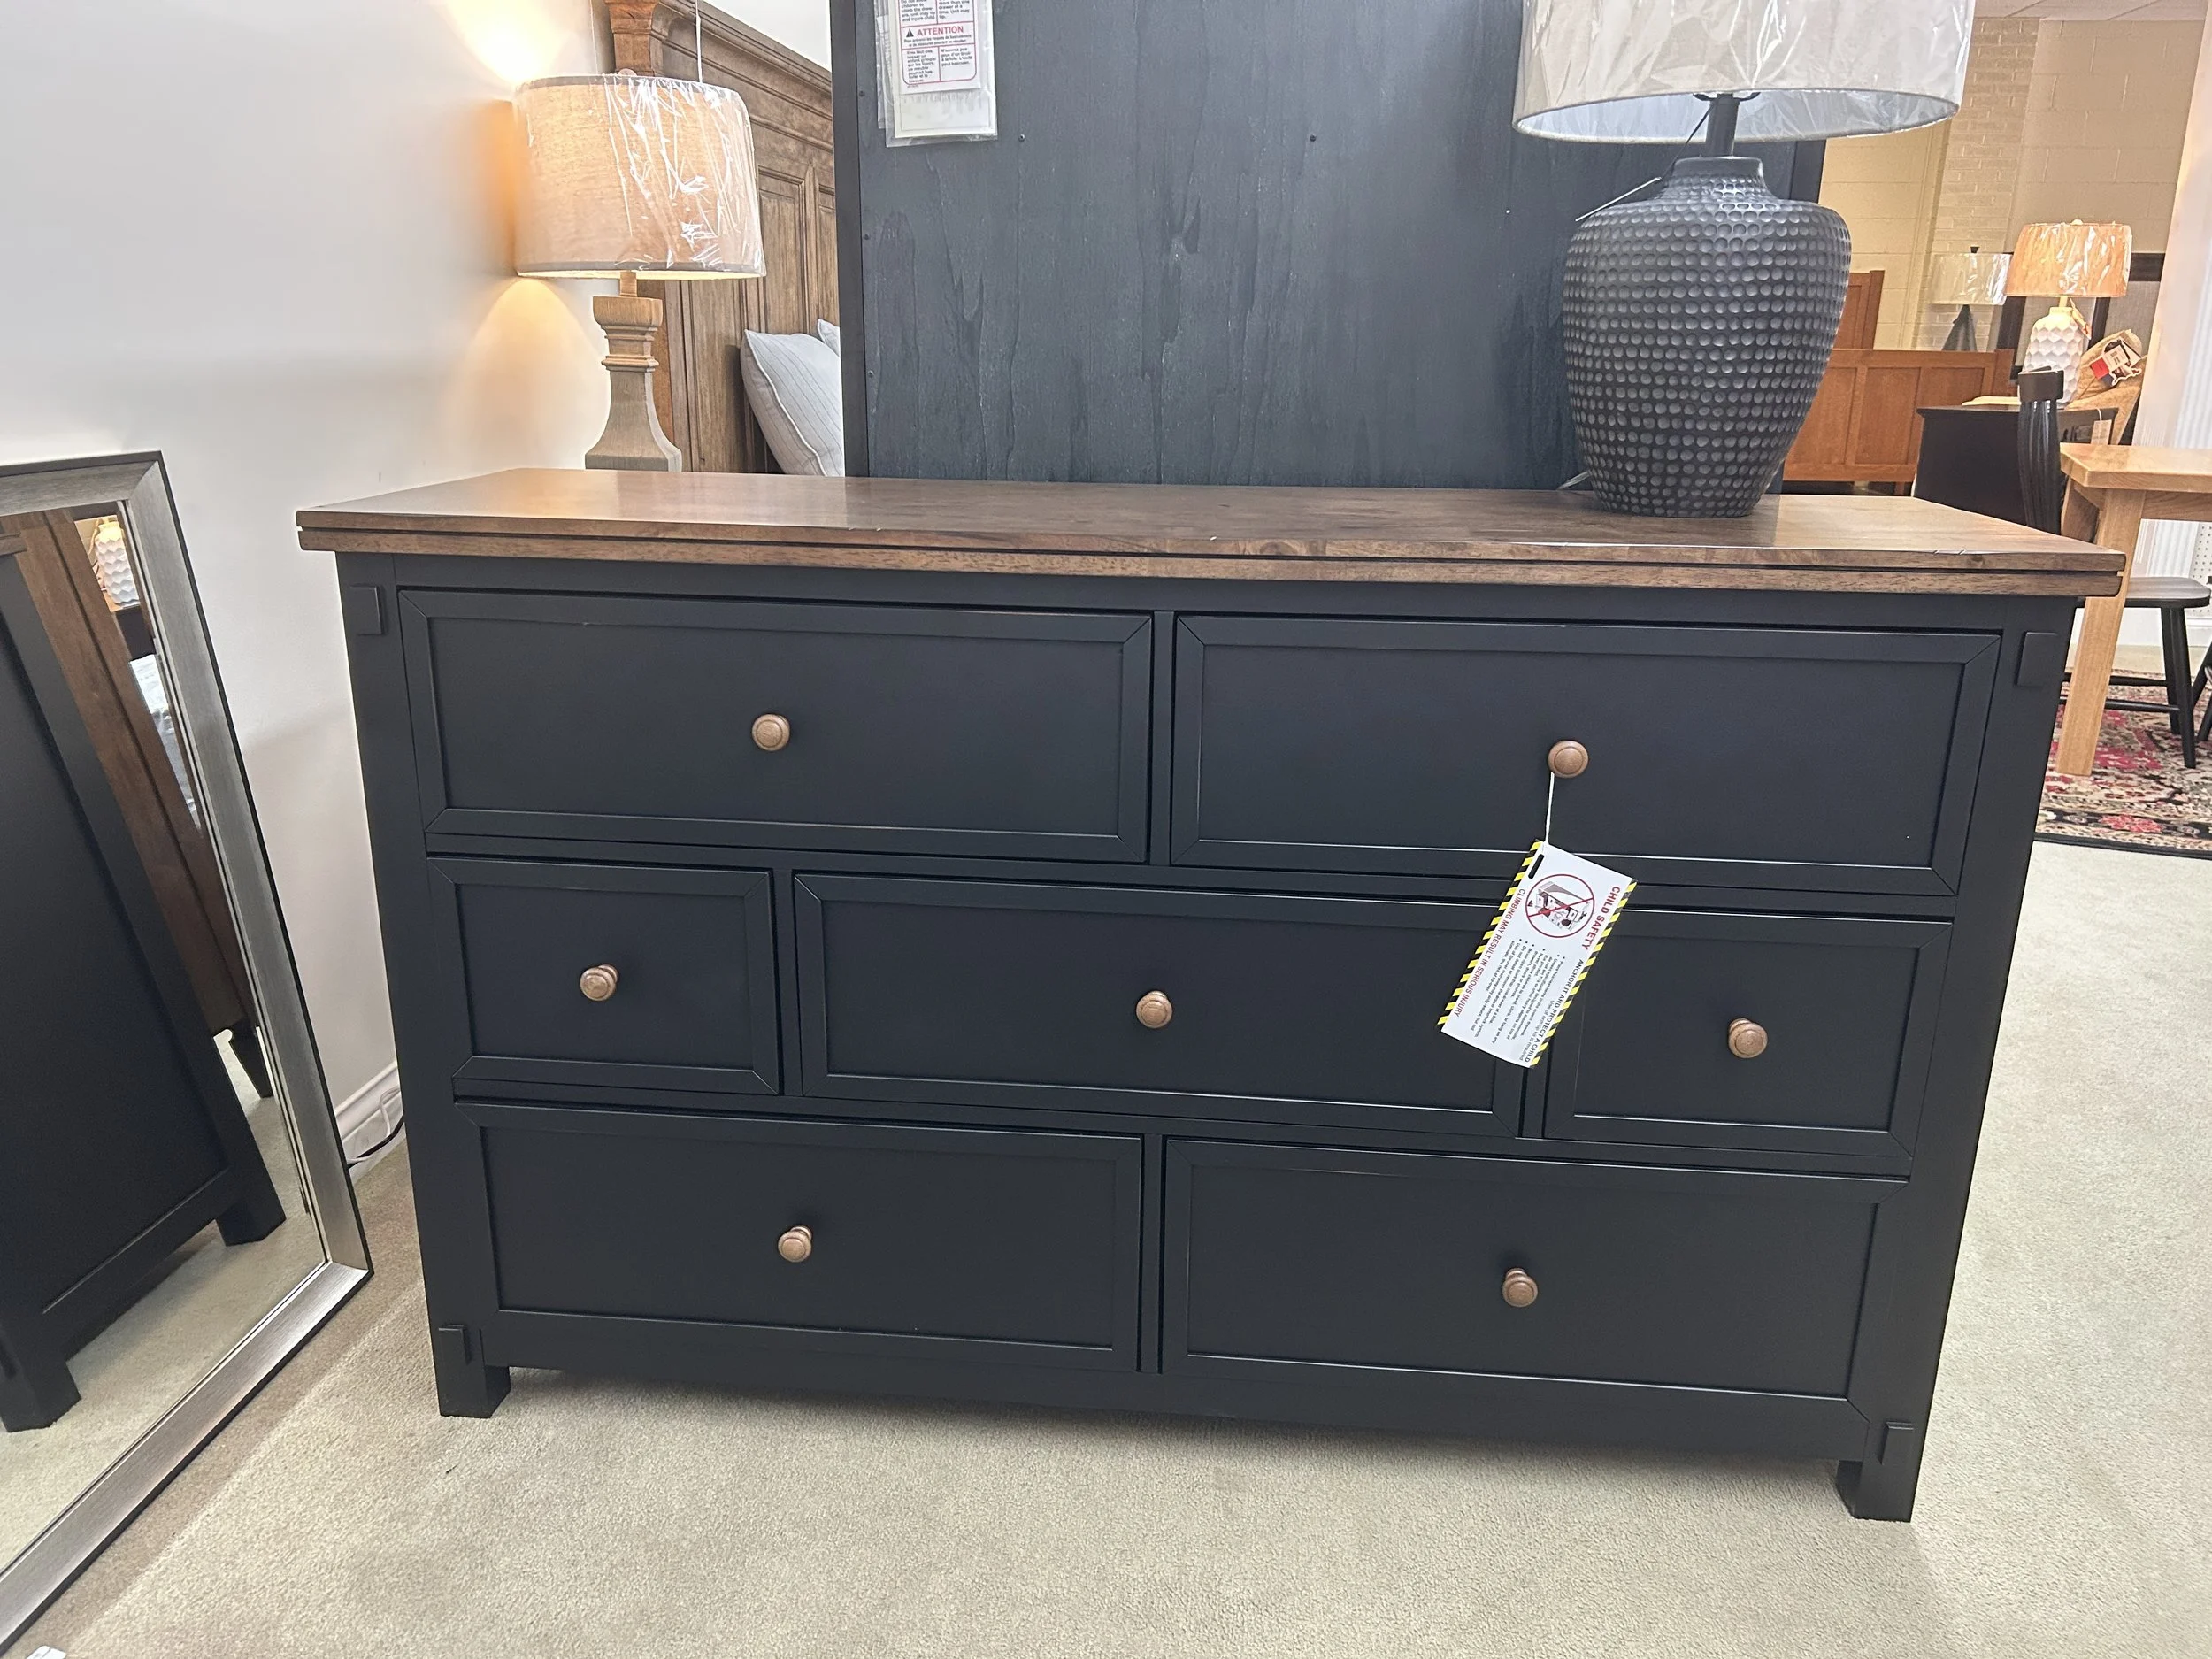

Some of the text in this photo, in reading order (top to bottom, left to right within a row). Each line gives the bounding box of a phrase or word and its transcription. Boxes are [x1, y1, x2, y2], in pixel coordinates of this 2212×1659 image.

[917, 26, 964, 36] ATTENTION
[1504, 887, 1525, 920] CLIMBING
[1496, 919, 1509, 933] MAY
[1581, 885, 1620, 949] CHILD SAFETY
[1484, 933, 1502, 959] RESULT
[1464, 965, 1484, 994] SERIOUS
[1565, 958, 1584, 987] ANCHOR
[1453, 994, 1469, 1017] INJURY
[1554, 994, 1564, 1008] AND
[1538, 1008, 1556, 1037] PROTECT
[1524, 1043, 1538, 1063] CHILD
